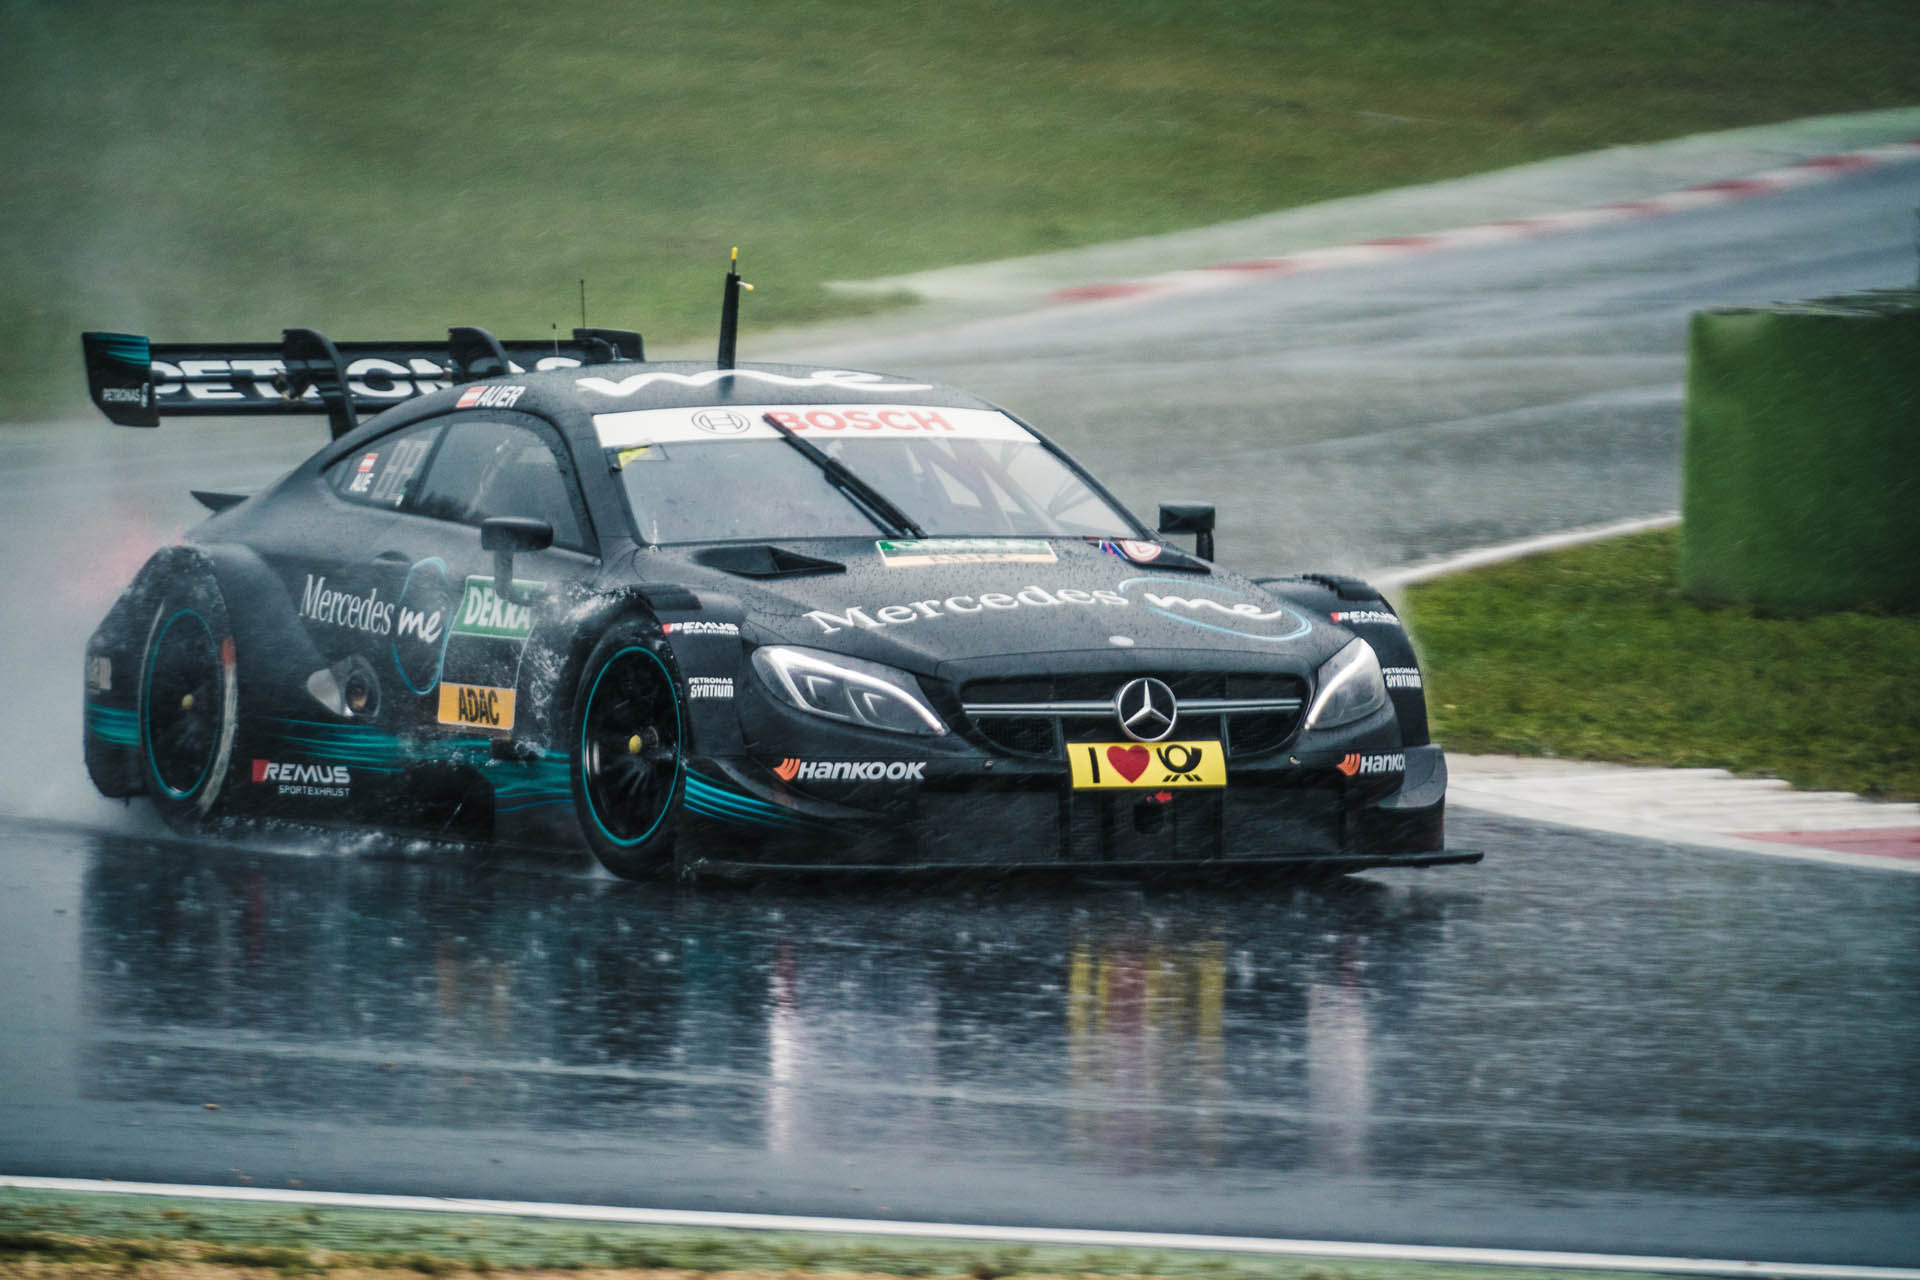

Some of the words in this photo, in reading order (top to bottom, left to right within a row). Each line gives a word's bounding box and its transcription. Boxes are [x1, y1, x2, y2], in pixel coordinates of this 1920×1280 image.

[576, 369, 934, 397] me
[476, 386, 527, 408] AUER
[768, 410, 953, 432] BOSCH
[299, 573, 395, 636] Mercedes
[398, 605, 444, 644] me
[802, 585, 1130, 634] Mercedes
[1144, 592, 1283, 620] me
[668, 621, 739, 632] REMUS
[690, 685, 734, 698] SYNTIUM
[458, 687, 500, 726] ADAC
[263, 762, 351, 784] REMUS
[1088, 747, 1100, 784] I
